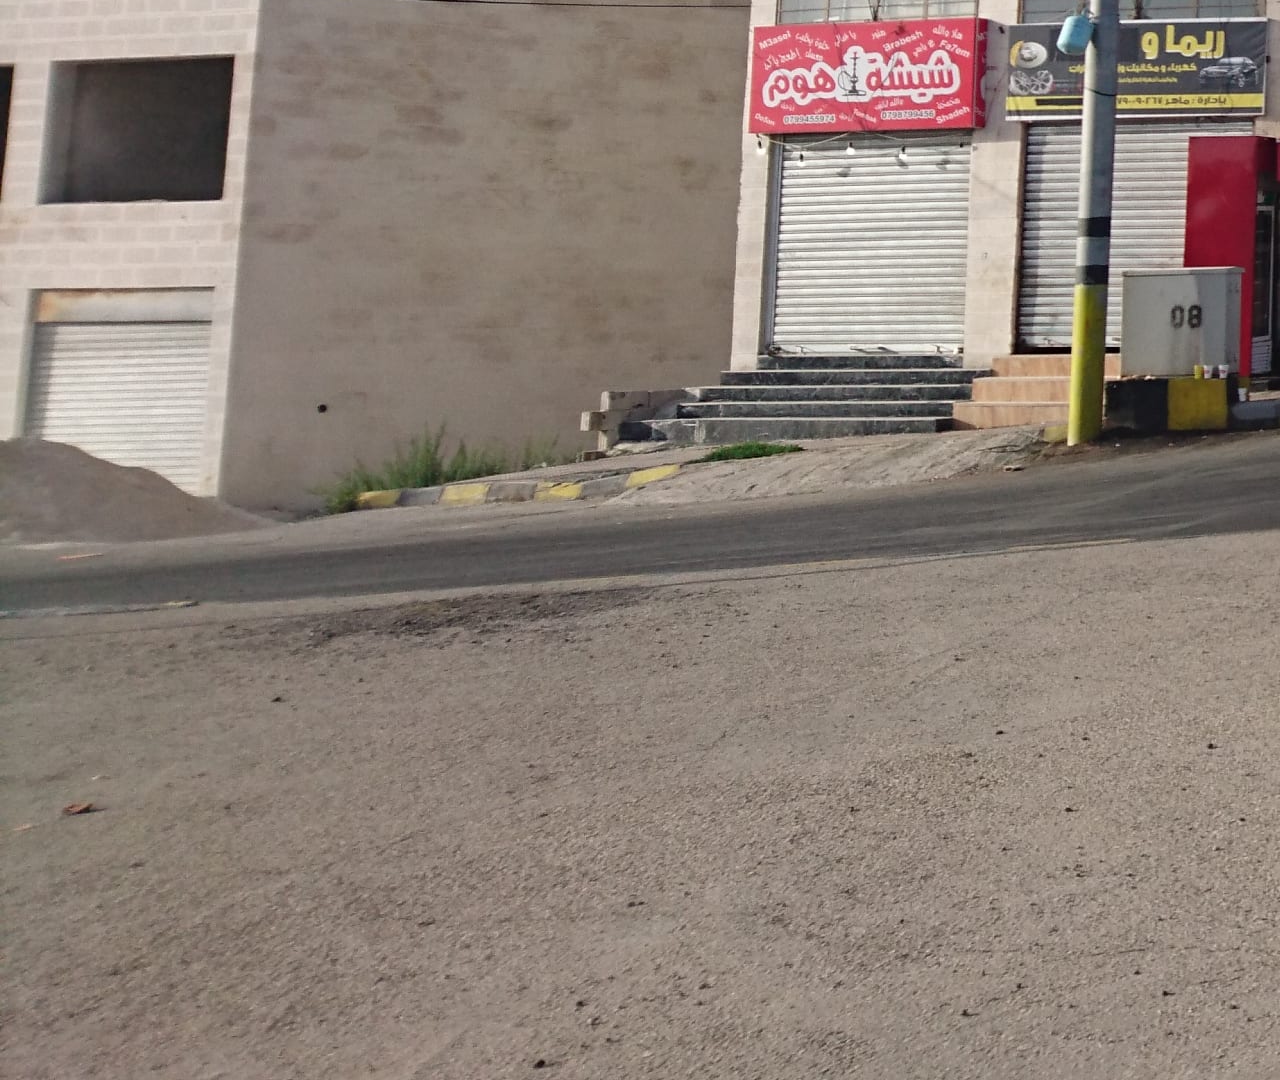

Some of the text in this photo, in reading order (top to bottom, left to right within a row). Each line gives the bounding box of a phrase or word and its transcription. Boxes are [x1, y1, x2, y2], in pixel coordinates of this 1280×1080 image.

[1165, 24, 1225, 59] ريما
[765, 52, 958, 106] شيشة هوم
[1170, 304, 1203, 328] 08
